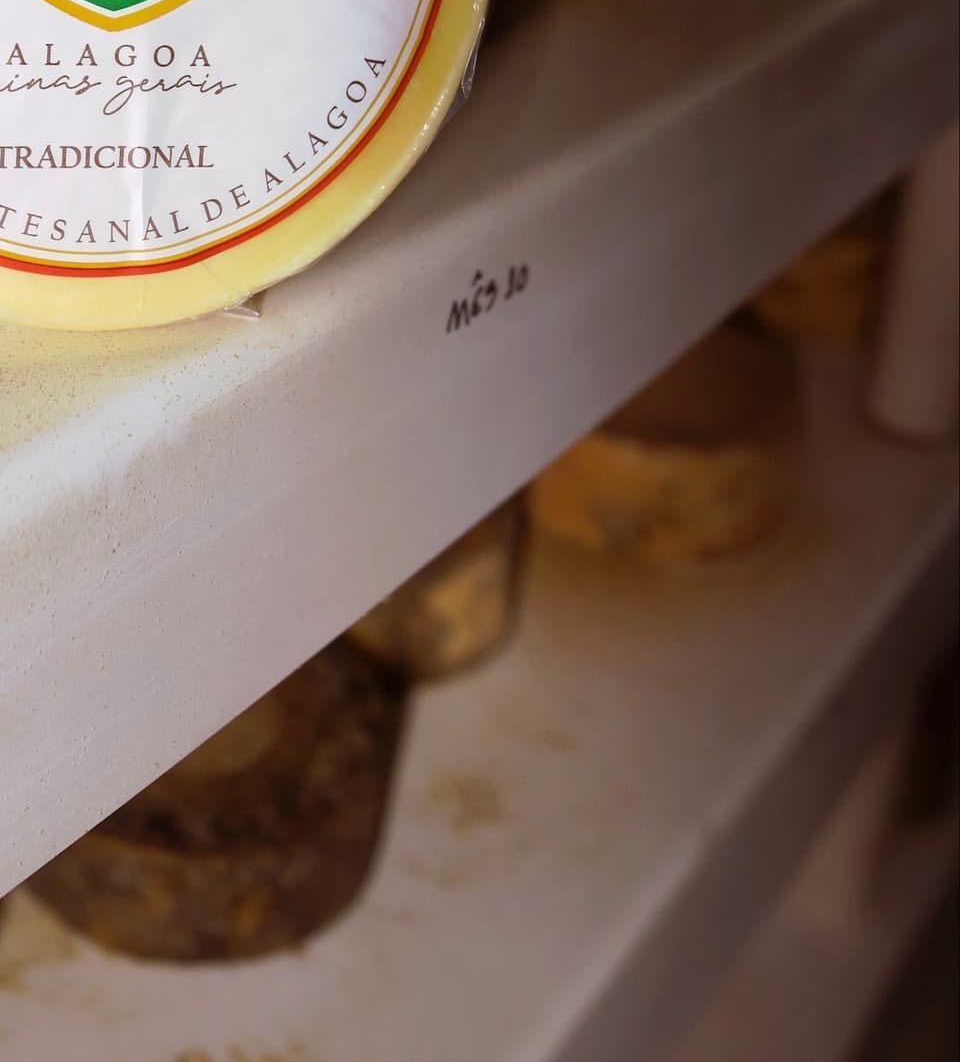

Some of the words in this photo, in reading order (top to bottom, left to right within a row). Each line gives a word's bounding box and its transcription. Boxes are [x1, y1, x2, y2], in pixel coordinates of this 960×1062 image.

[6, 42, 211, 68] ALAGOA
[102, 73, 237, 116] gerais
[200, 184, 251, 223] DE
[261, 55, 387, 193] ALAGOA
